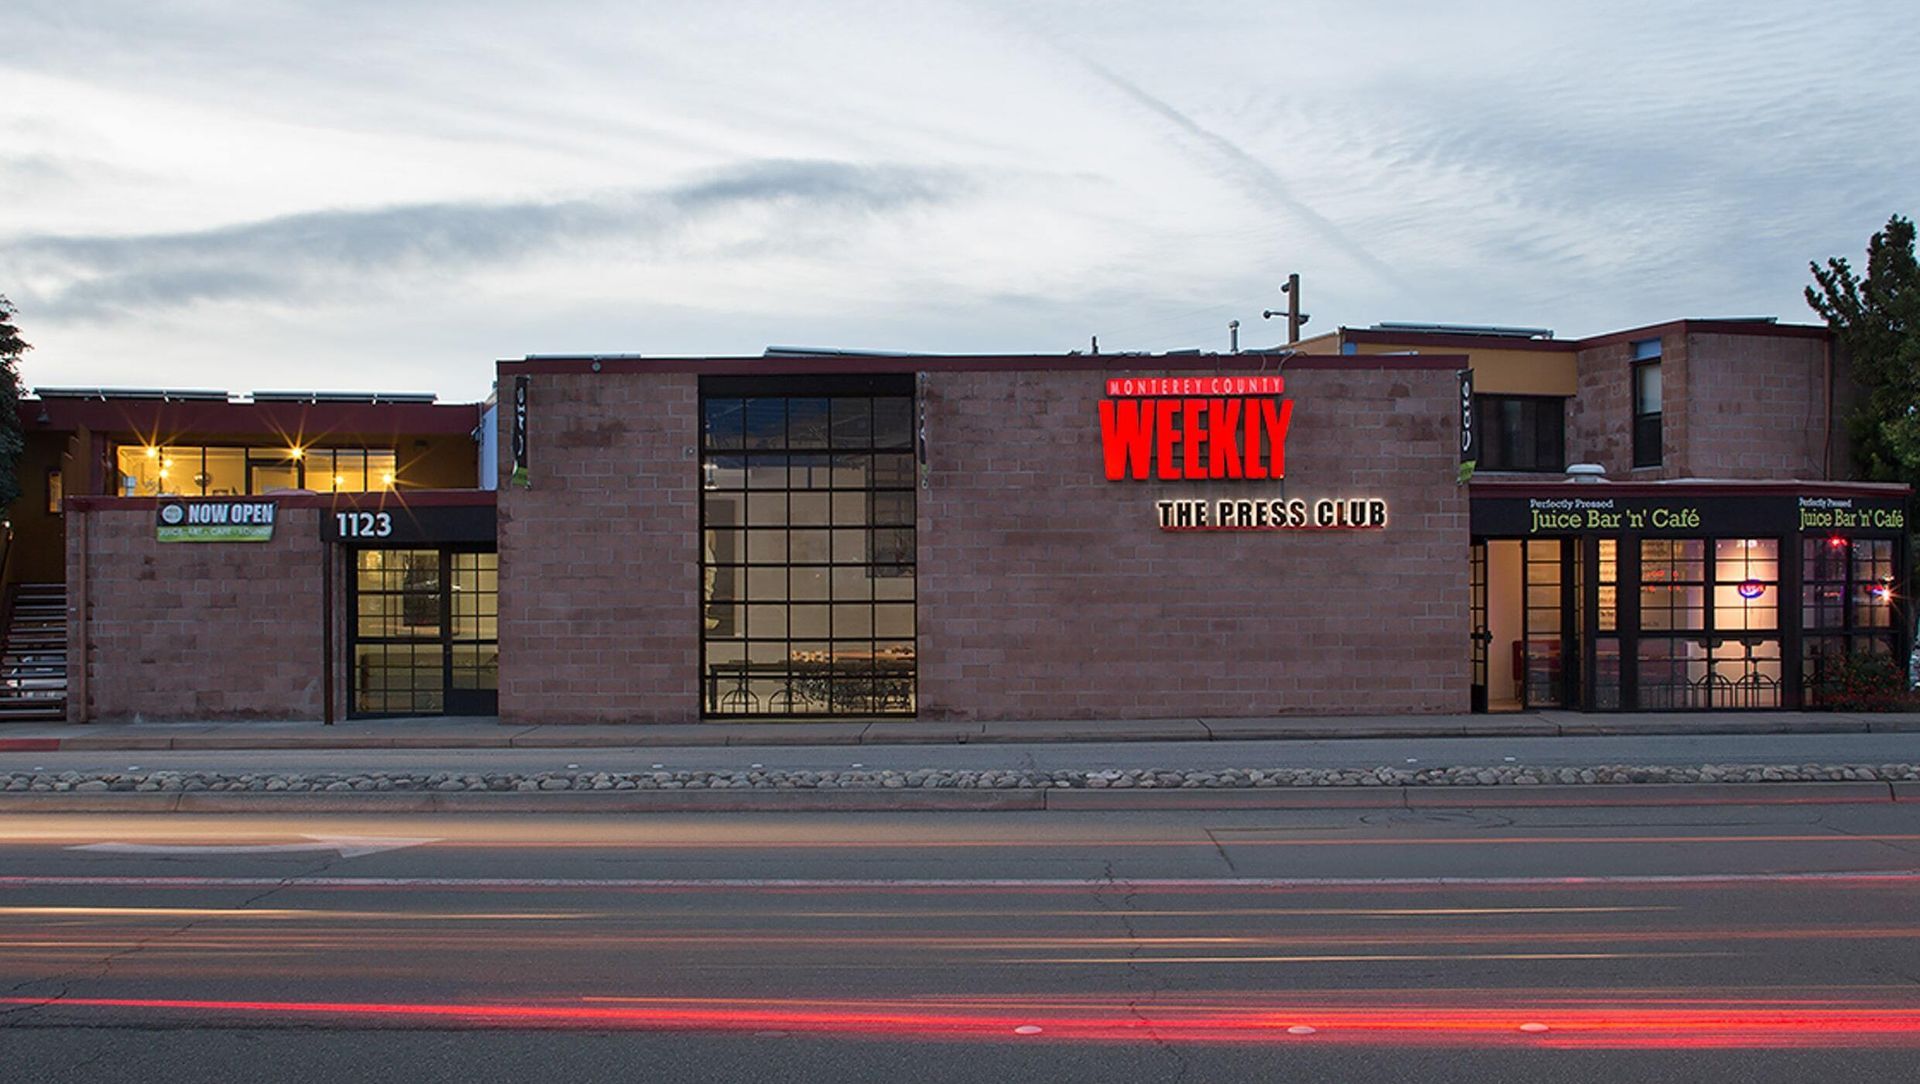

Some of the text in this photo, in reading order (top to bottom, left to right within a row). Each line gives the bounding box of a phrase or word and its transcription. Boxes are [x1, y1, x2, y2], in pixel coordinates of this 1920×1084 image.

[1110, 377, 1281, 395] MONTEREY COUNTY
[1098, 399, 1295, 480] WEEKLY
[188, 503, 229, 523] NOW
[231, 503, 273, 523] OPEN
[1158, 500, 1386, 527] THE PRESS CLUB
[1530, 499, 1614, 510] Perfectly Pressed
[336, 512, 392, 537] 1123
[1530, 509, 1582, 533] Juice
[1587, 509, 1622, 528] Bar
[1652, 508, 1700, 528] Café
[1799, 508, 1832, 531] Juice
[1834, 508, 1857, 527] Bar
[1874, 509, 1904, 528] Café
